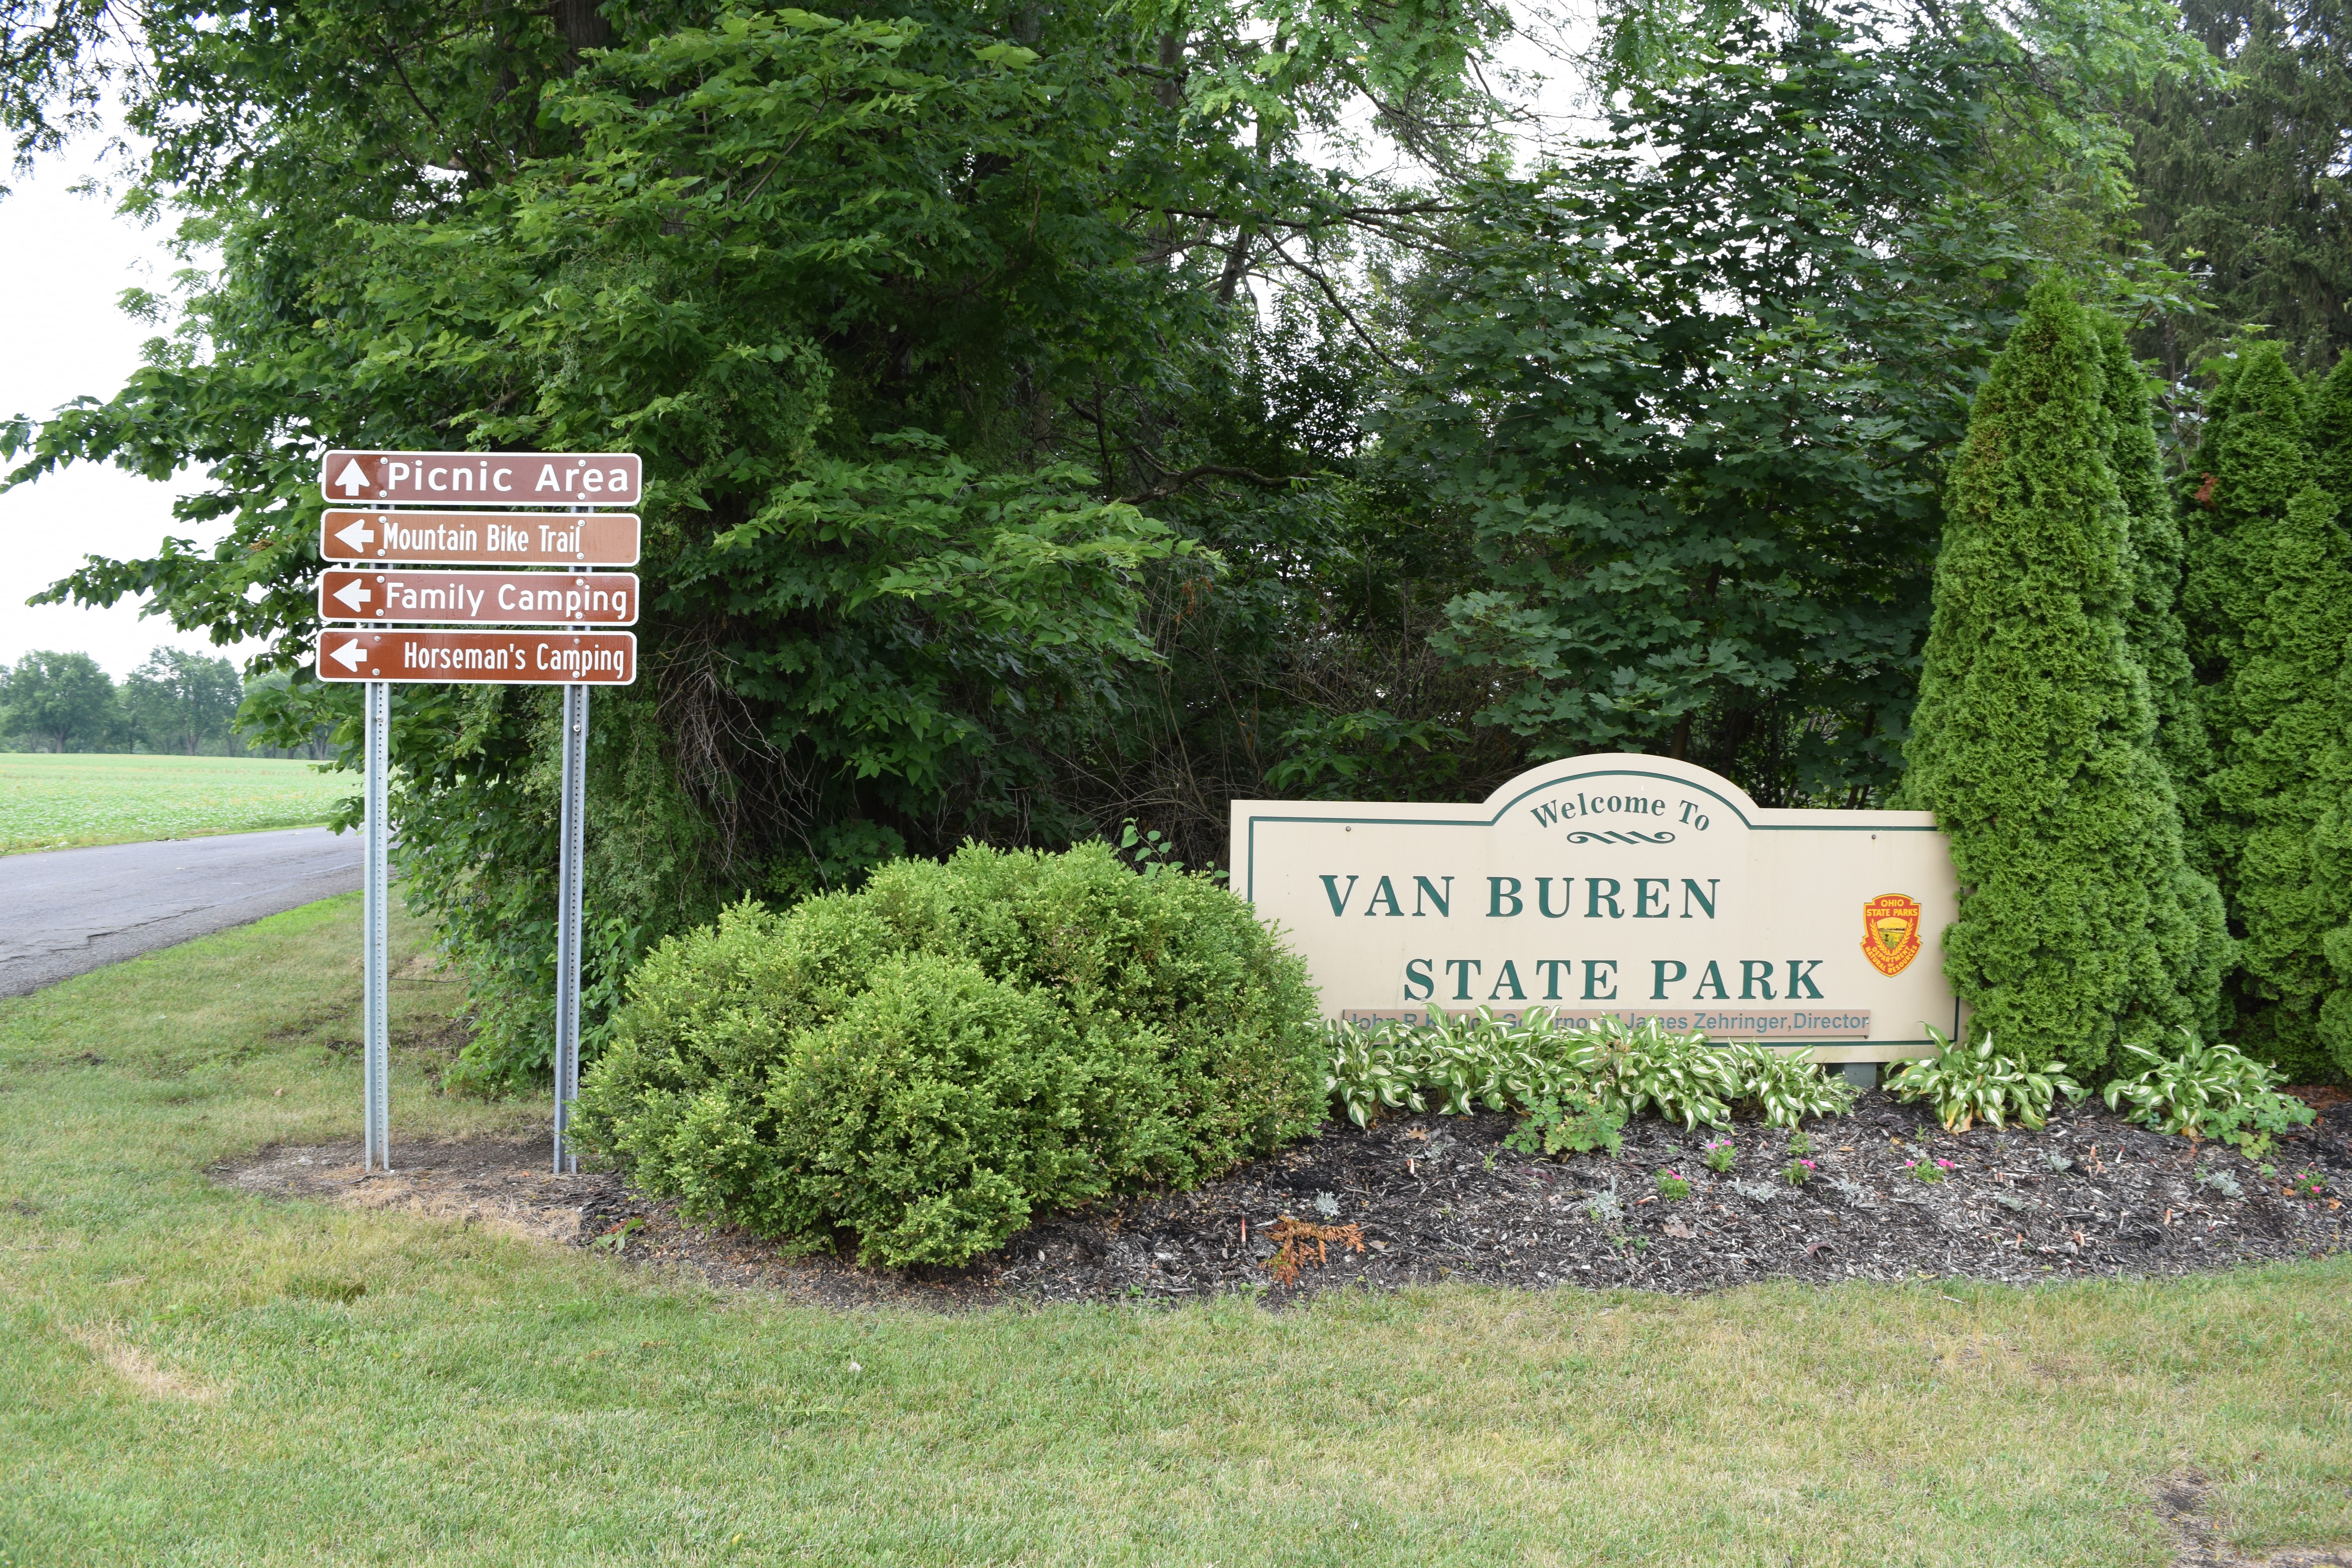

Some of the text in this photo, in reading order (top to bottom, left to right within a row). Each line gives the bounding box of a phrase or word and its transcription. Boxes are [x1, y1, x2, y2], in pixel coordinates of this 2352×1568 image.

[388, 460, 629, 492] Picnic Area
[383, 522, 581, 553] Mountain Bike Trail
[386, 582, 627, 620] Family Camping
[404, 641, 624, 679] Horseman's Camping
[1530, 793, 1710, 831] Welcome To
[1319, 875, 1720, 919] VAN BUREN
[1865, 945, 1918, 973] NATURAL RESOURCES
[1872, 946, 1910, 963] DEPARTMENT
[1404, 958, 1824, 1001] STATE PARK
[1624, 1013, 1688, 1029] Jaes
